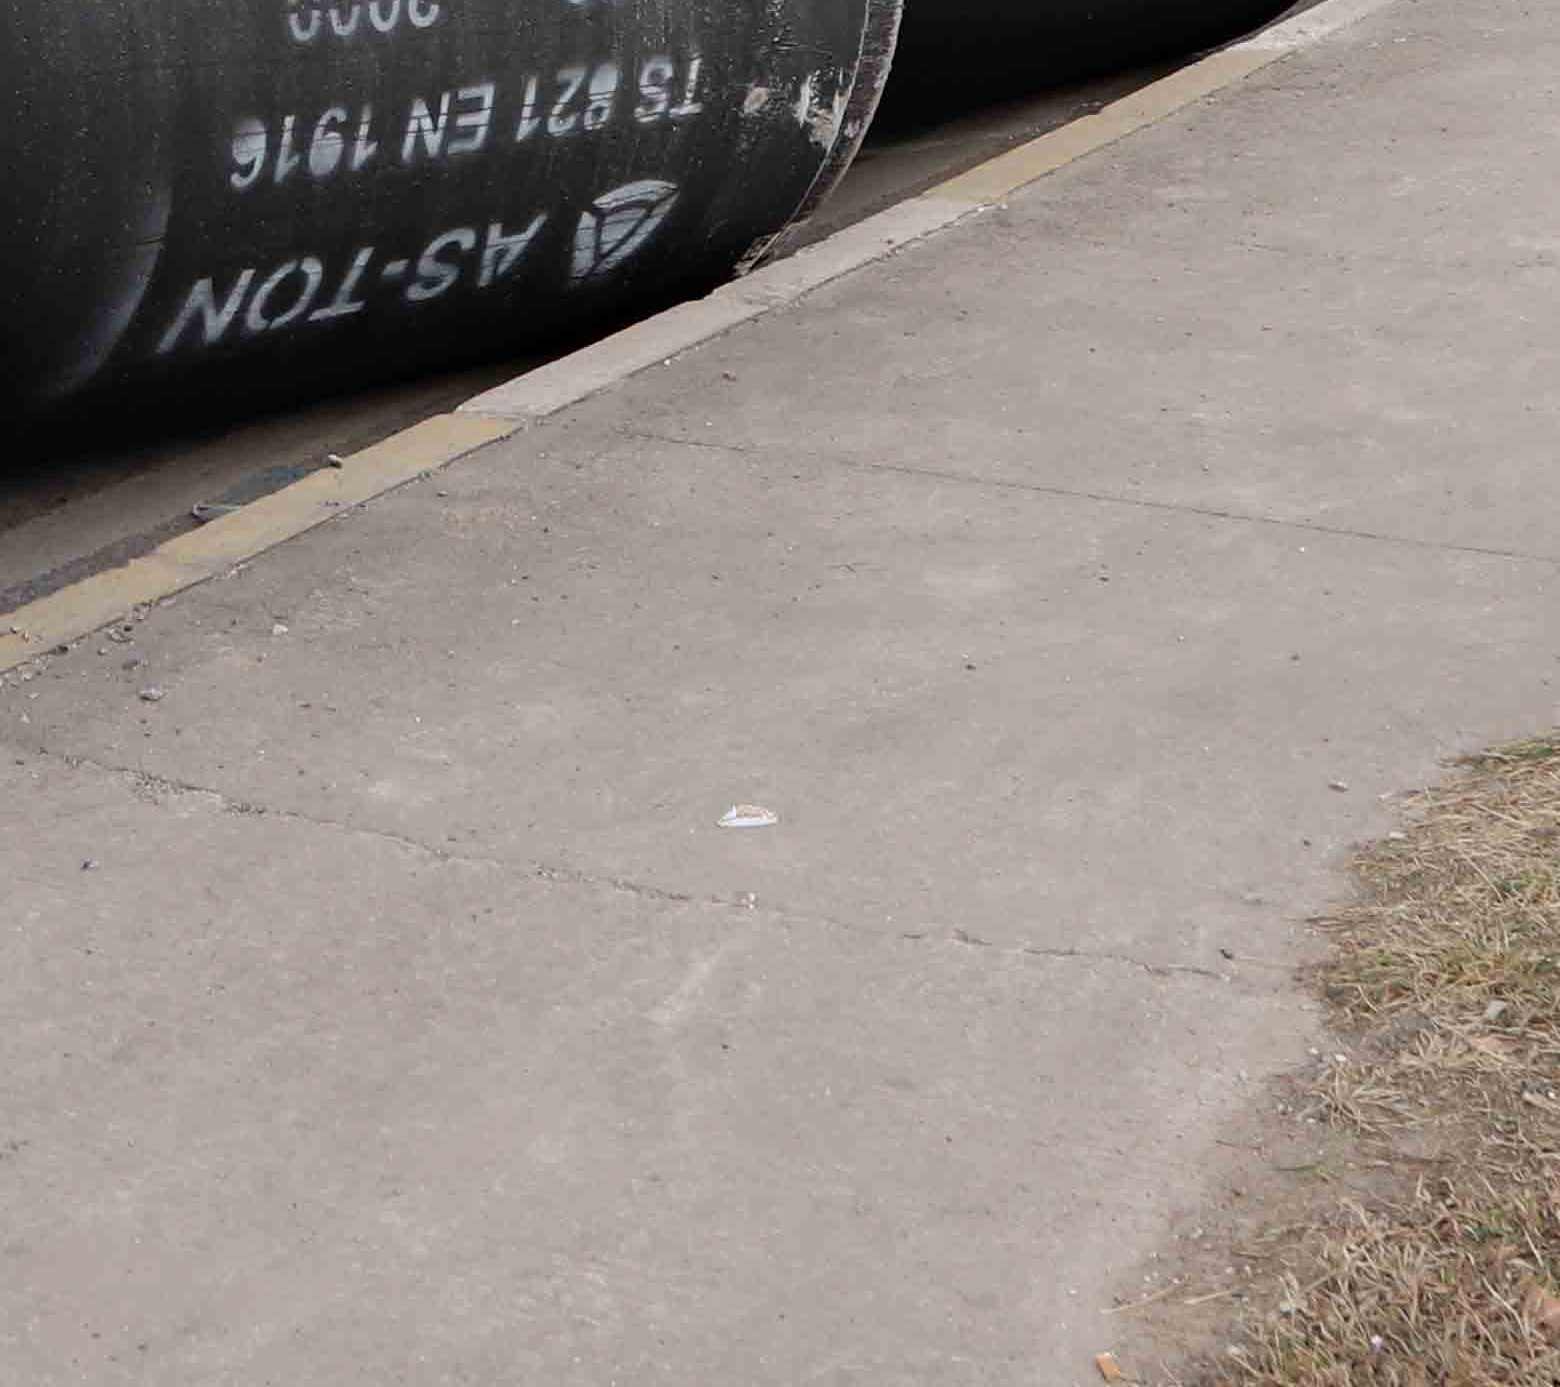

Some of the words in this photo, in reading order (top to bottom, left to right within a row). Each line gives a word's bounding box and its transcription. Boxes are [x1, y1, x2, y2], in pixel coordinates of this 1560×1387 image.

[402, 84, 497, 169] EN
[513, 63, 621, 145] 821
[637, 54, 704, 123] TS
[228, 115, 375, 191] 1916
[156, 211, 549, 356] AS-TON
